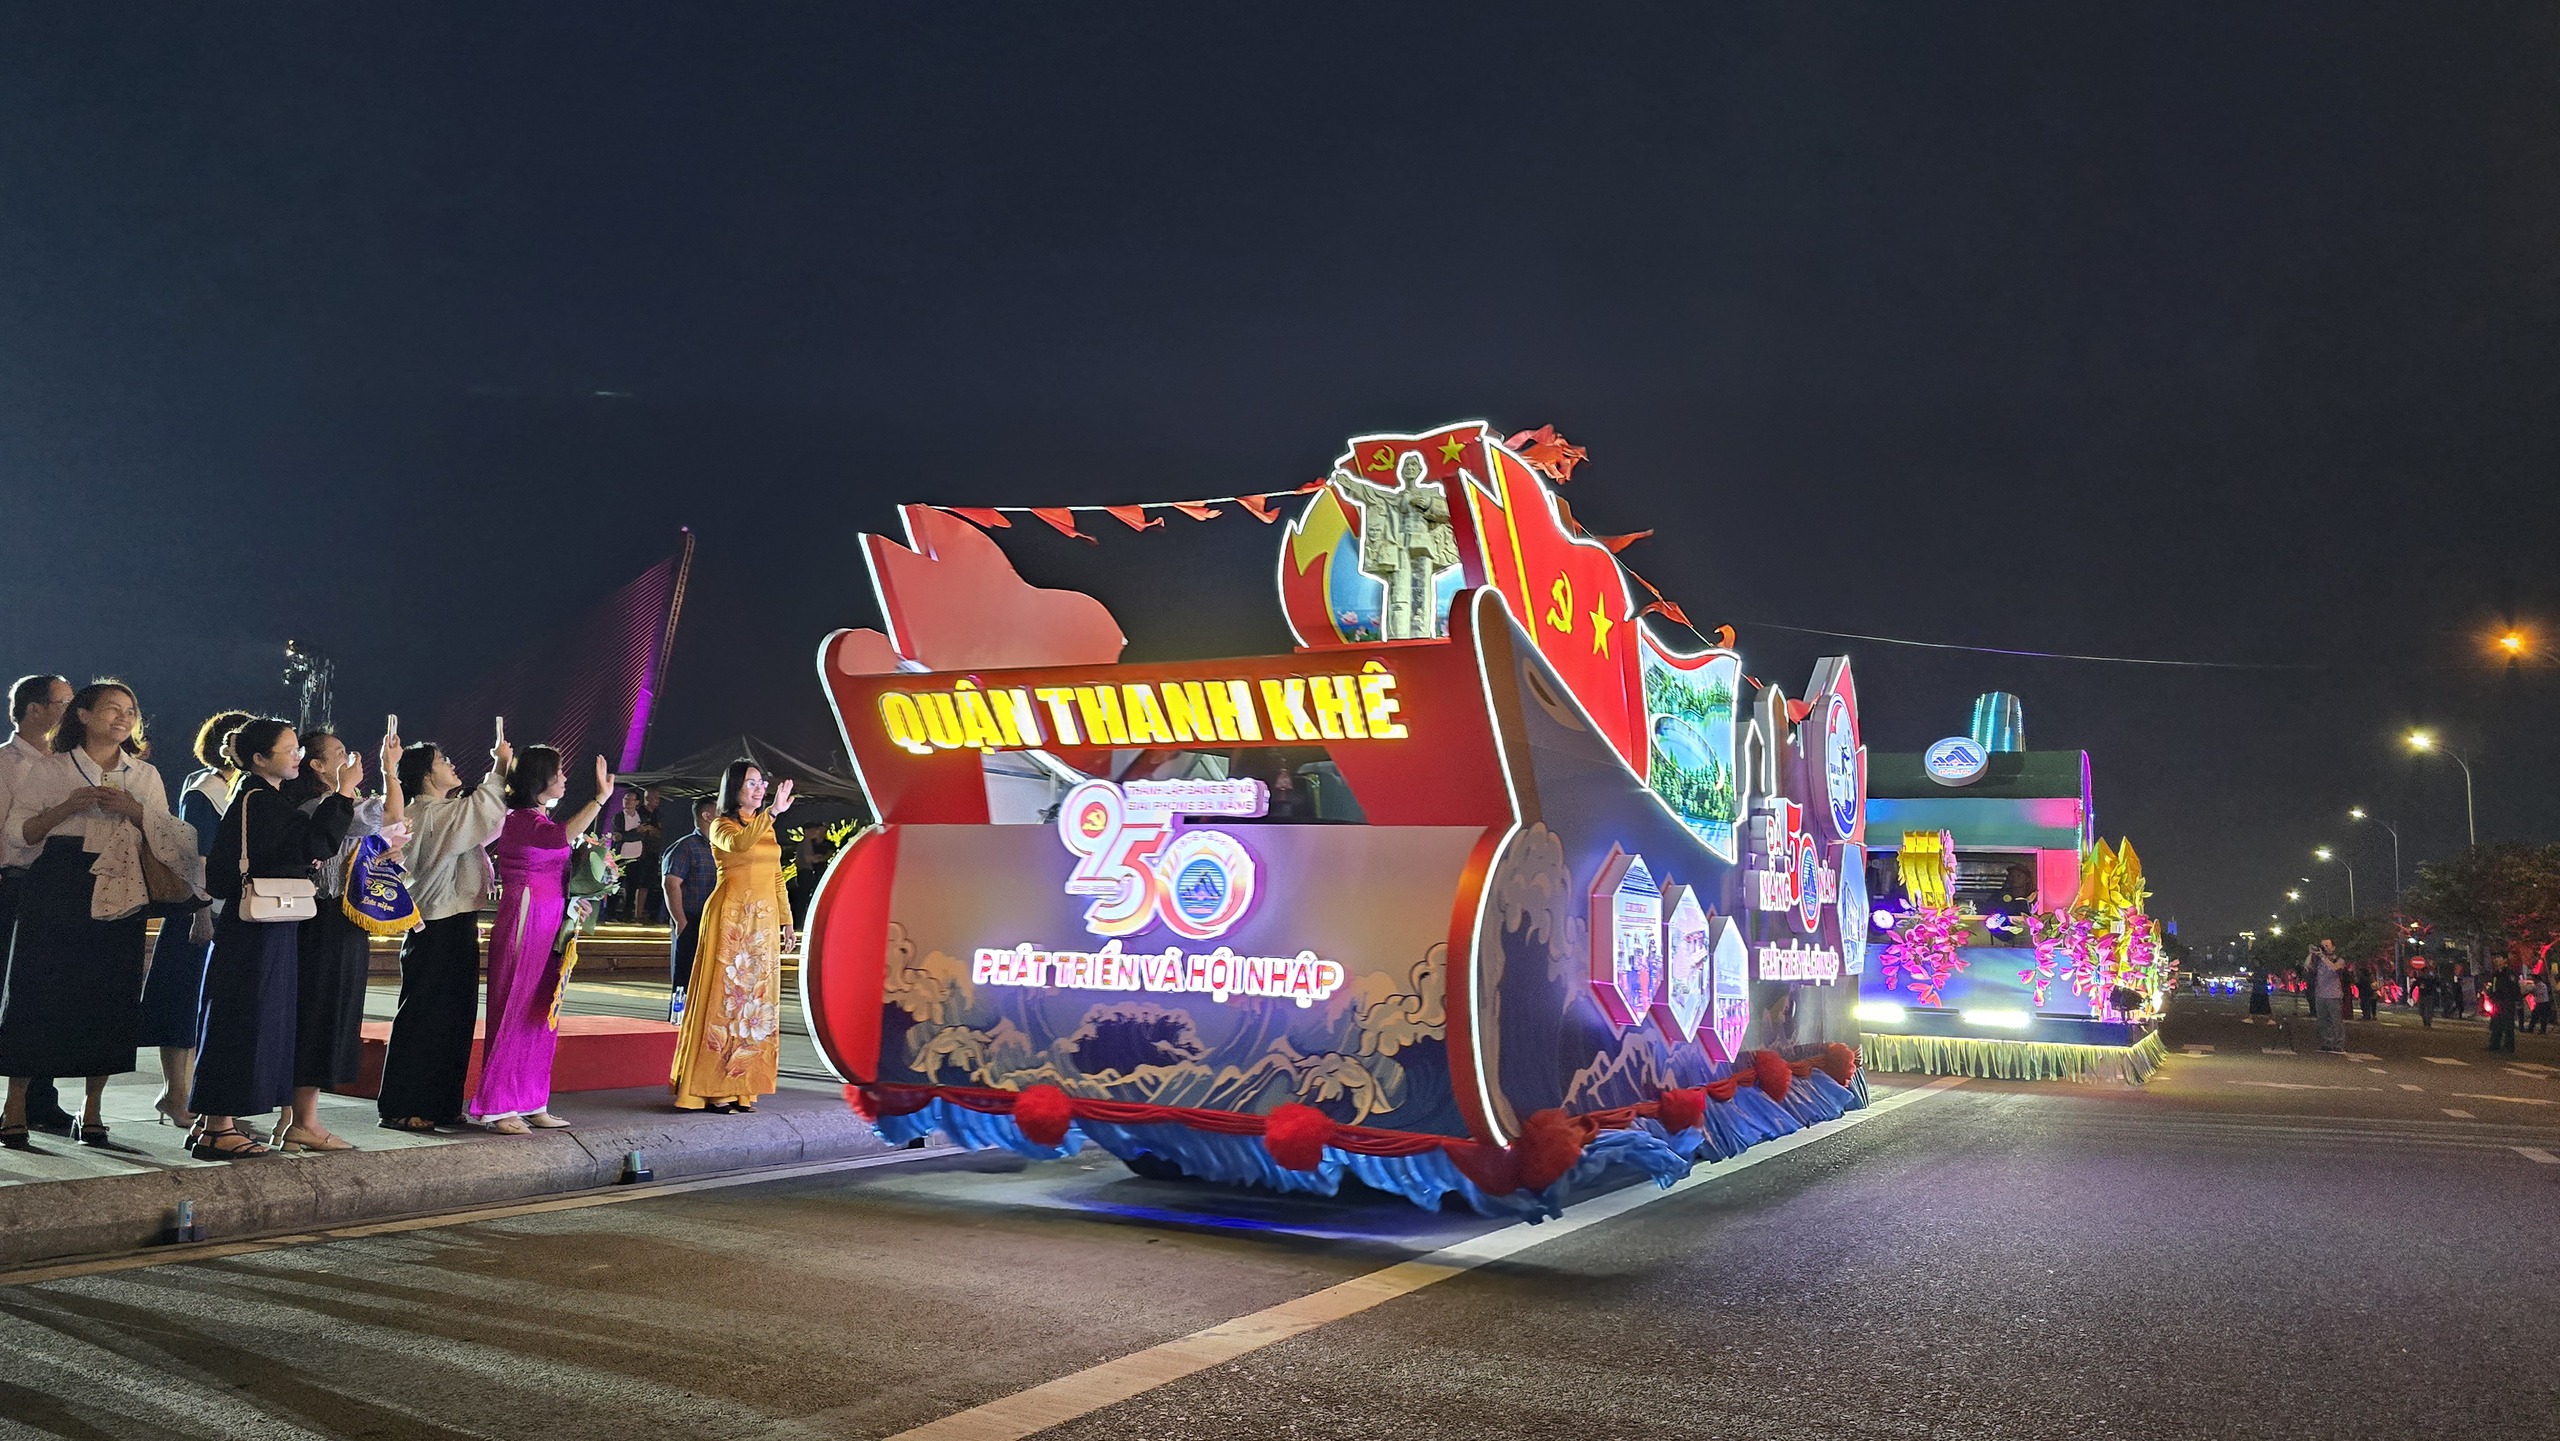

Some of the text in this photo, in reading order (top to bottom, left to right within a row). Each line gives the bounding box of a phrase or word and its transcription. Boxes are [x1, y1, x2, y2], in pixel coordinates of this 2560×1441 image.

[878, 661, 1409, 755] QUẬN THANH KHÊ
[973, 942, 1051, 987] PHÁT
[1142, 946, 1186, 992] VÀ
[1187, 946, 1243, 1002] HỘI
[1244, 950, 1344, 1007] NHẬP
